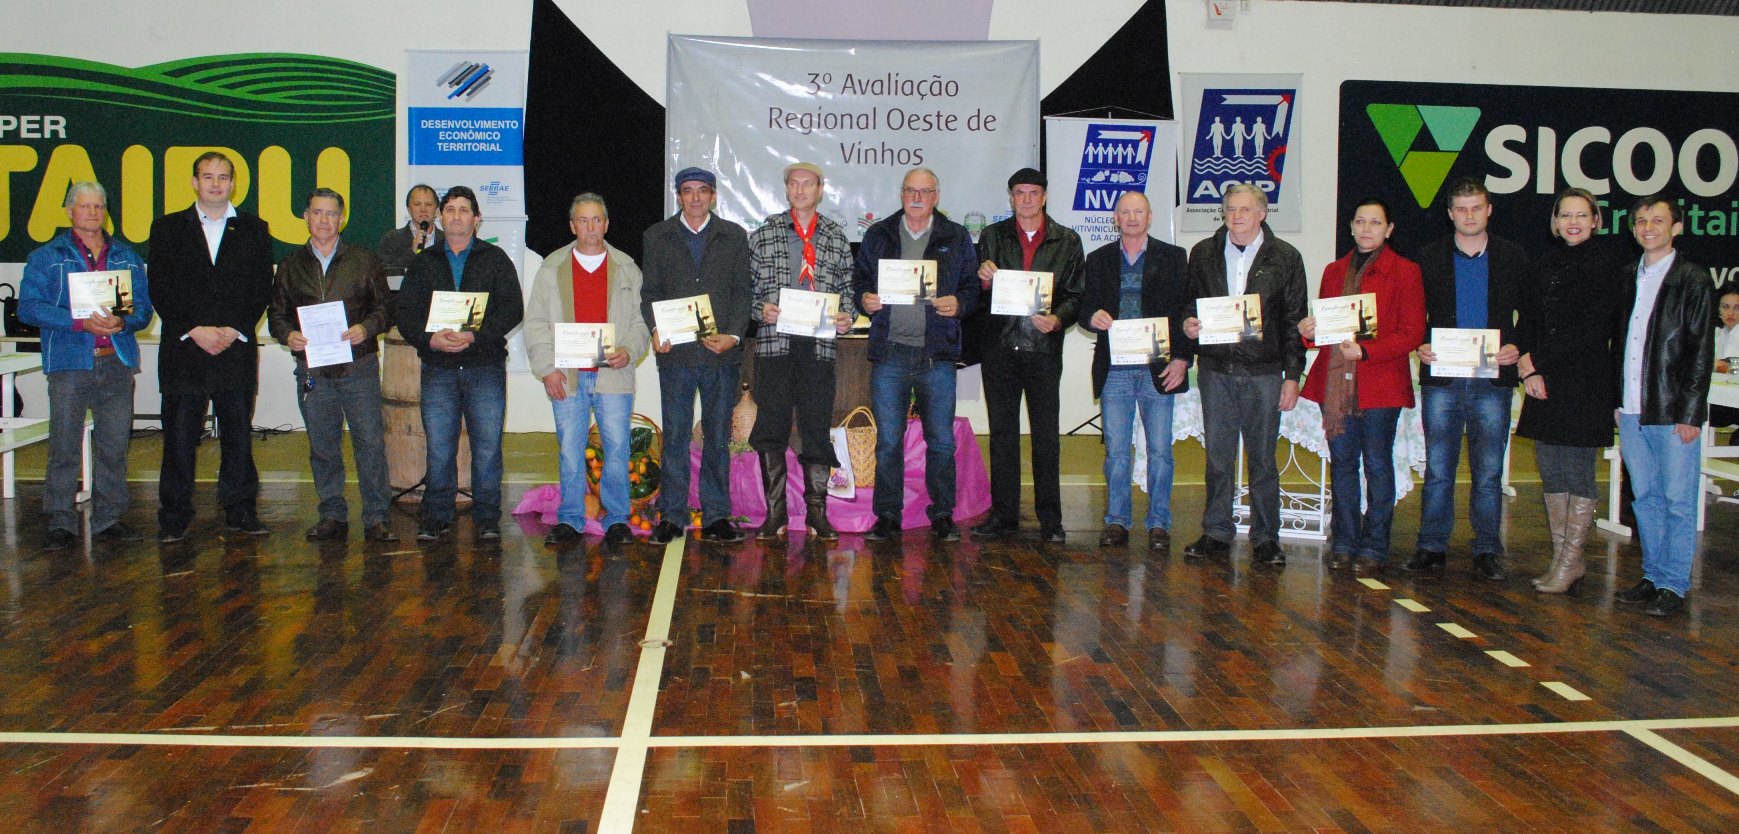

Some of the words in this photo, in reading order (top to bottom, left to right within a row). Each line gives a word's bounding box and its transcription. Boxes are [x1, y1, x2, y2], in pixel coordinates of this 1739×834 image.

[806, 72, 832, 95] 3º
[841, 72, 960, 100] Avaliação
[421, 120, 518, 129] DESENVOLVIMENTO
[768, 106, 877, 135] Regional
[886, 108, 958, 132] Oeste
[967, 108, 998, 132] de
[439, 130, 500, 140] ECONÔMICO
[437, 143, 502, 151] TERRITORIAL
[839, 141, 924, 166] Vinhos
[1484, 124, 1739, 197] SICOO
[1084, 189, 1127, 209] NV
[1192, 180, 1276, 198] ACP
